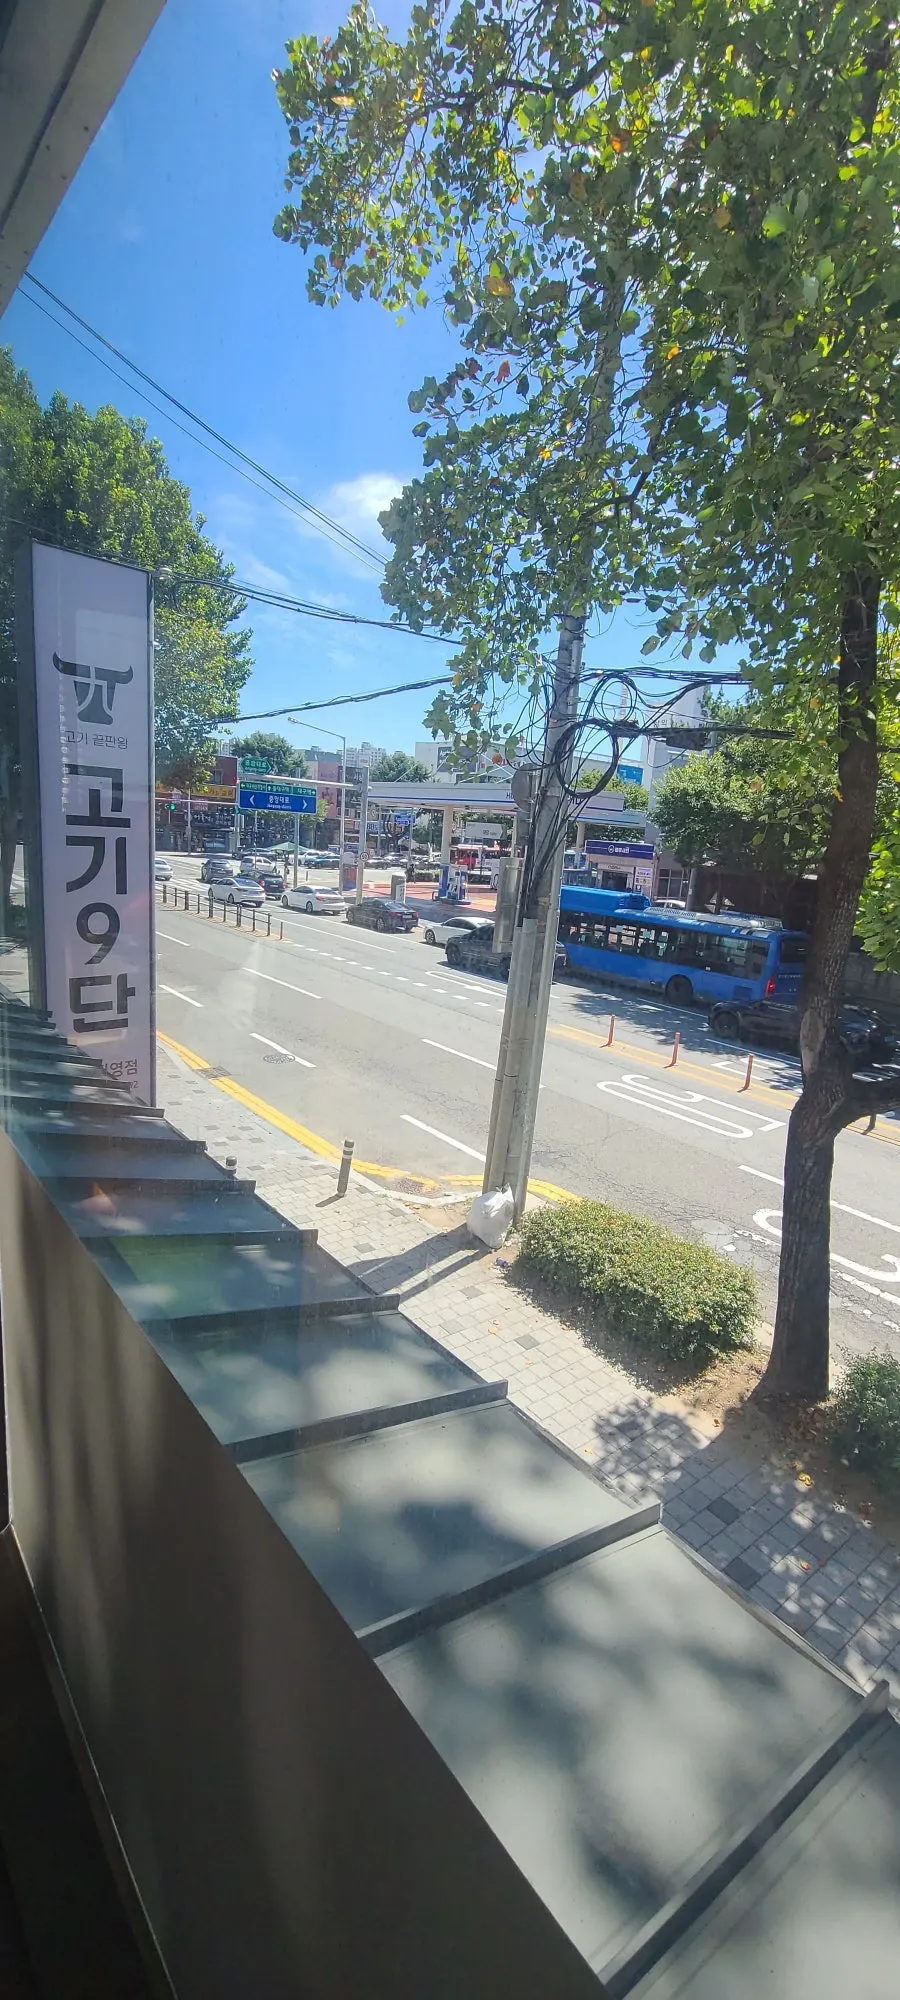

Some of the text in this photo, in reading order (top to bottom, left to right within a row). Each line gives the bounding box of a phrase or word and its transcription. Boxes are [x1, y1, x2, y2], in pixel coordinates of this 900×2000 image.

[64, 730, 128, 750] 고기 끝판왕
[268, 795, 291, 804] 중앙대로
[65, 763, 136, 1035] 고기9단
[102, 1058, 138, 1078] 영점
